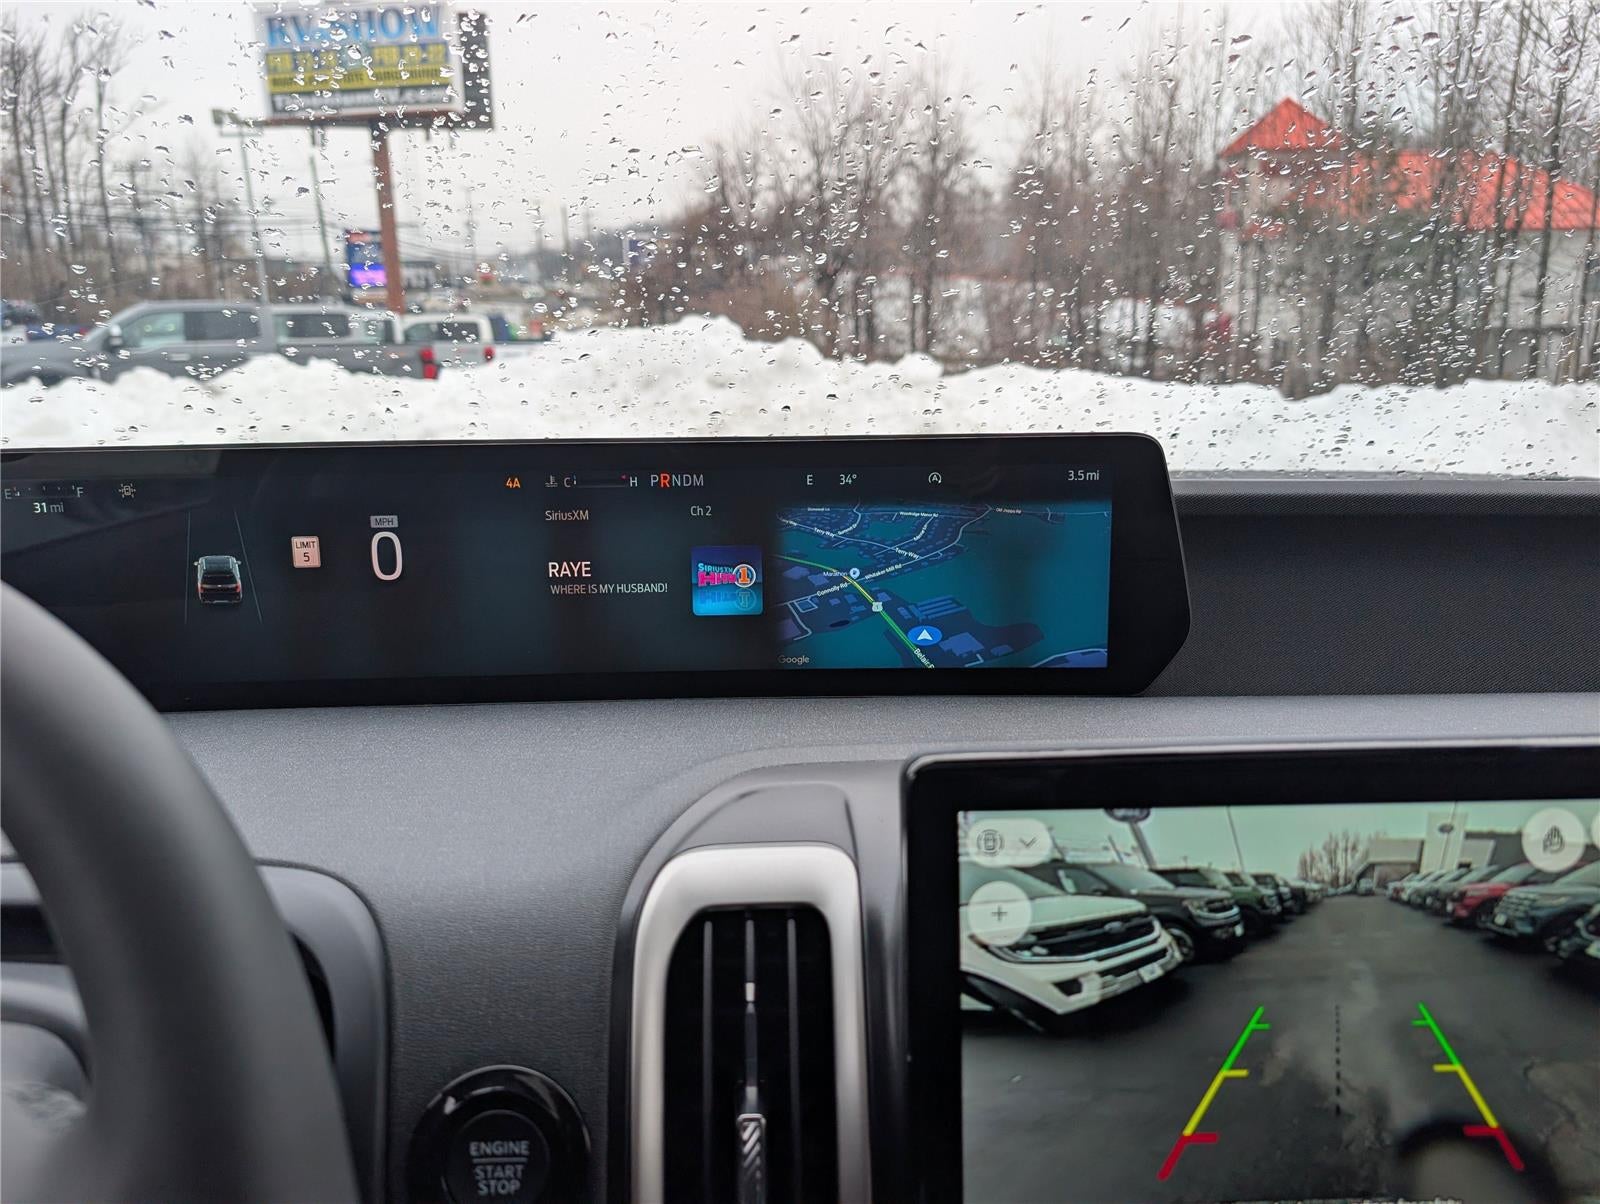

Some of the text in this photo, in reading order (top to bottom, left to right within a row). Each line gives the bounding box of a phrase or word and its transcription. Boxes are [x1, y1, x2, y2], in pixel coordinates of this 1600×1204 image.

[806, 474, 813, 485] E
[840, 474, 857, 485] 34°
[1068, 470, 1100, 480] 3.5 mi
[505, 477, 521, 488] 4A
[563, 477, 571, 488] C
[630, 476, 638, 487] H
[4, 488, 12, 499] E
[76, 486, 84, 498] F
[33, 502, 64, 513] 31 mi
[690, 505, 712, 516] Ch 2
[545, 510, 589, 521] SiriusXM
[375, 518, 394, 526] MPH
[296, 541, 316, 549] LIMIT
[303, 552, 310, 562] 5
[371, 531, 403, 581] 0
[896, 547, 920, 560] Terry Way
[548, 561, 592, 577] RAYE
[738, 567, 750, 583] 1
[550, 583, 668, 594] WHERE IS MY HUSBAND!
[816, 584, 840, 597] Connolly
[778, 655, 809, 665] Google
[469, 1140, 530, 1156] ENGINE
[474, 1165, 524, 1180] START
[478, 1180, 521, 1196] STOP
